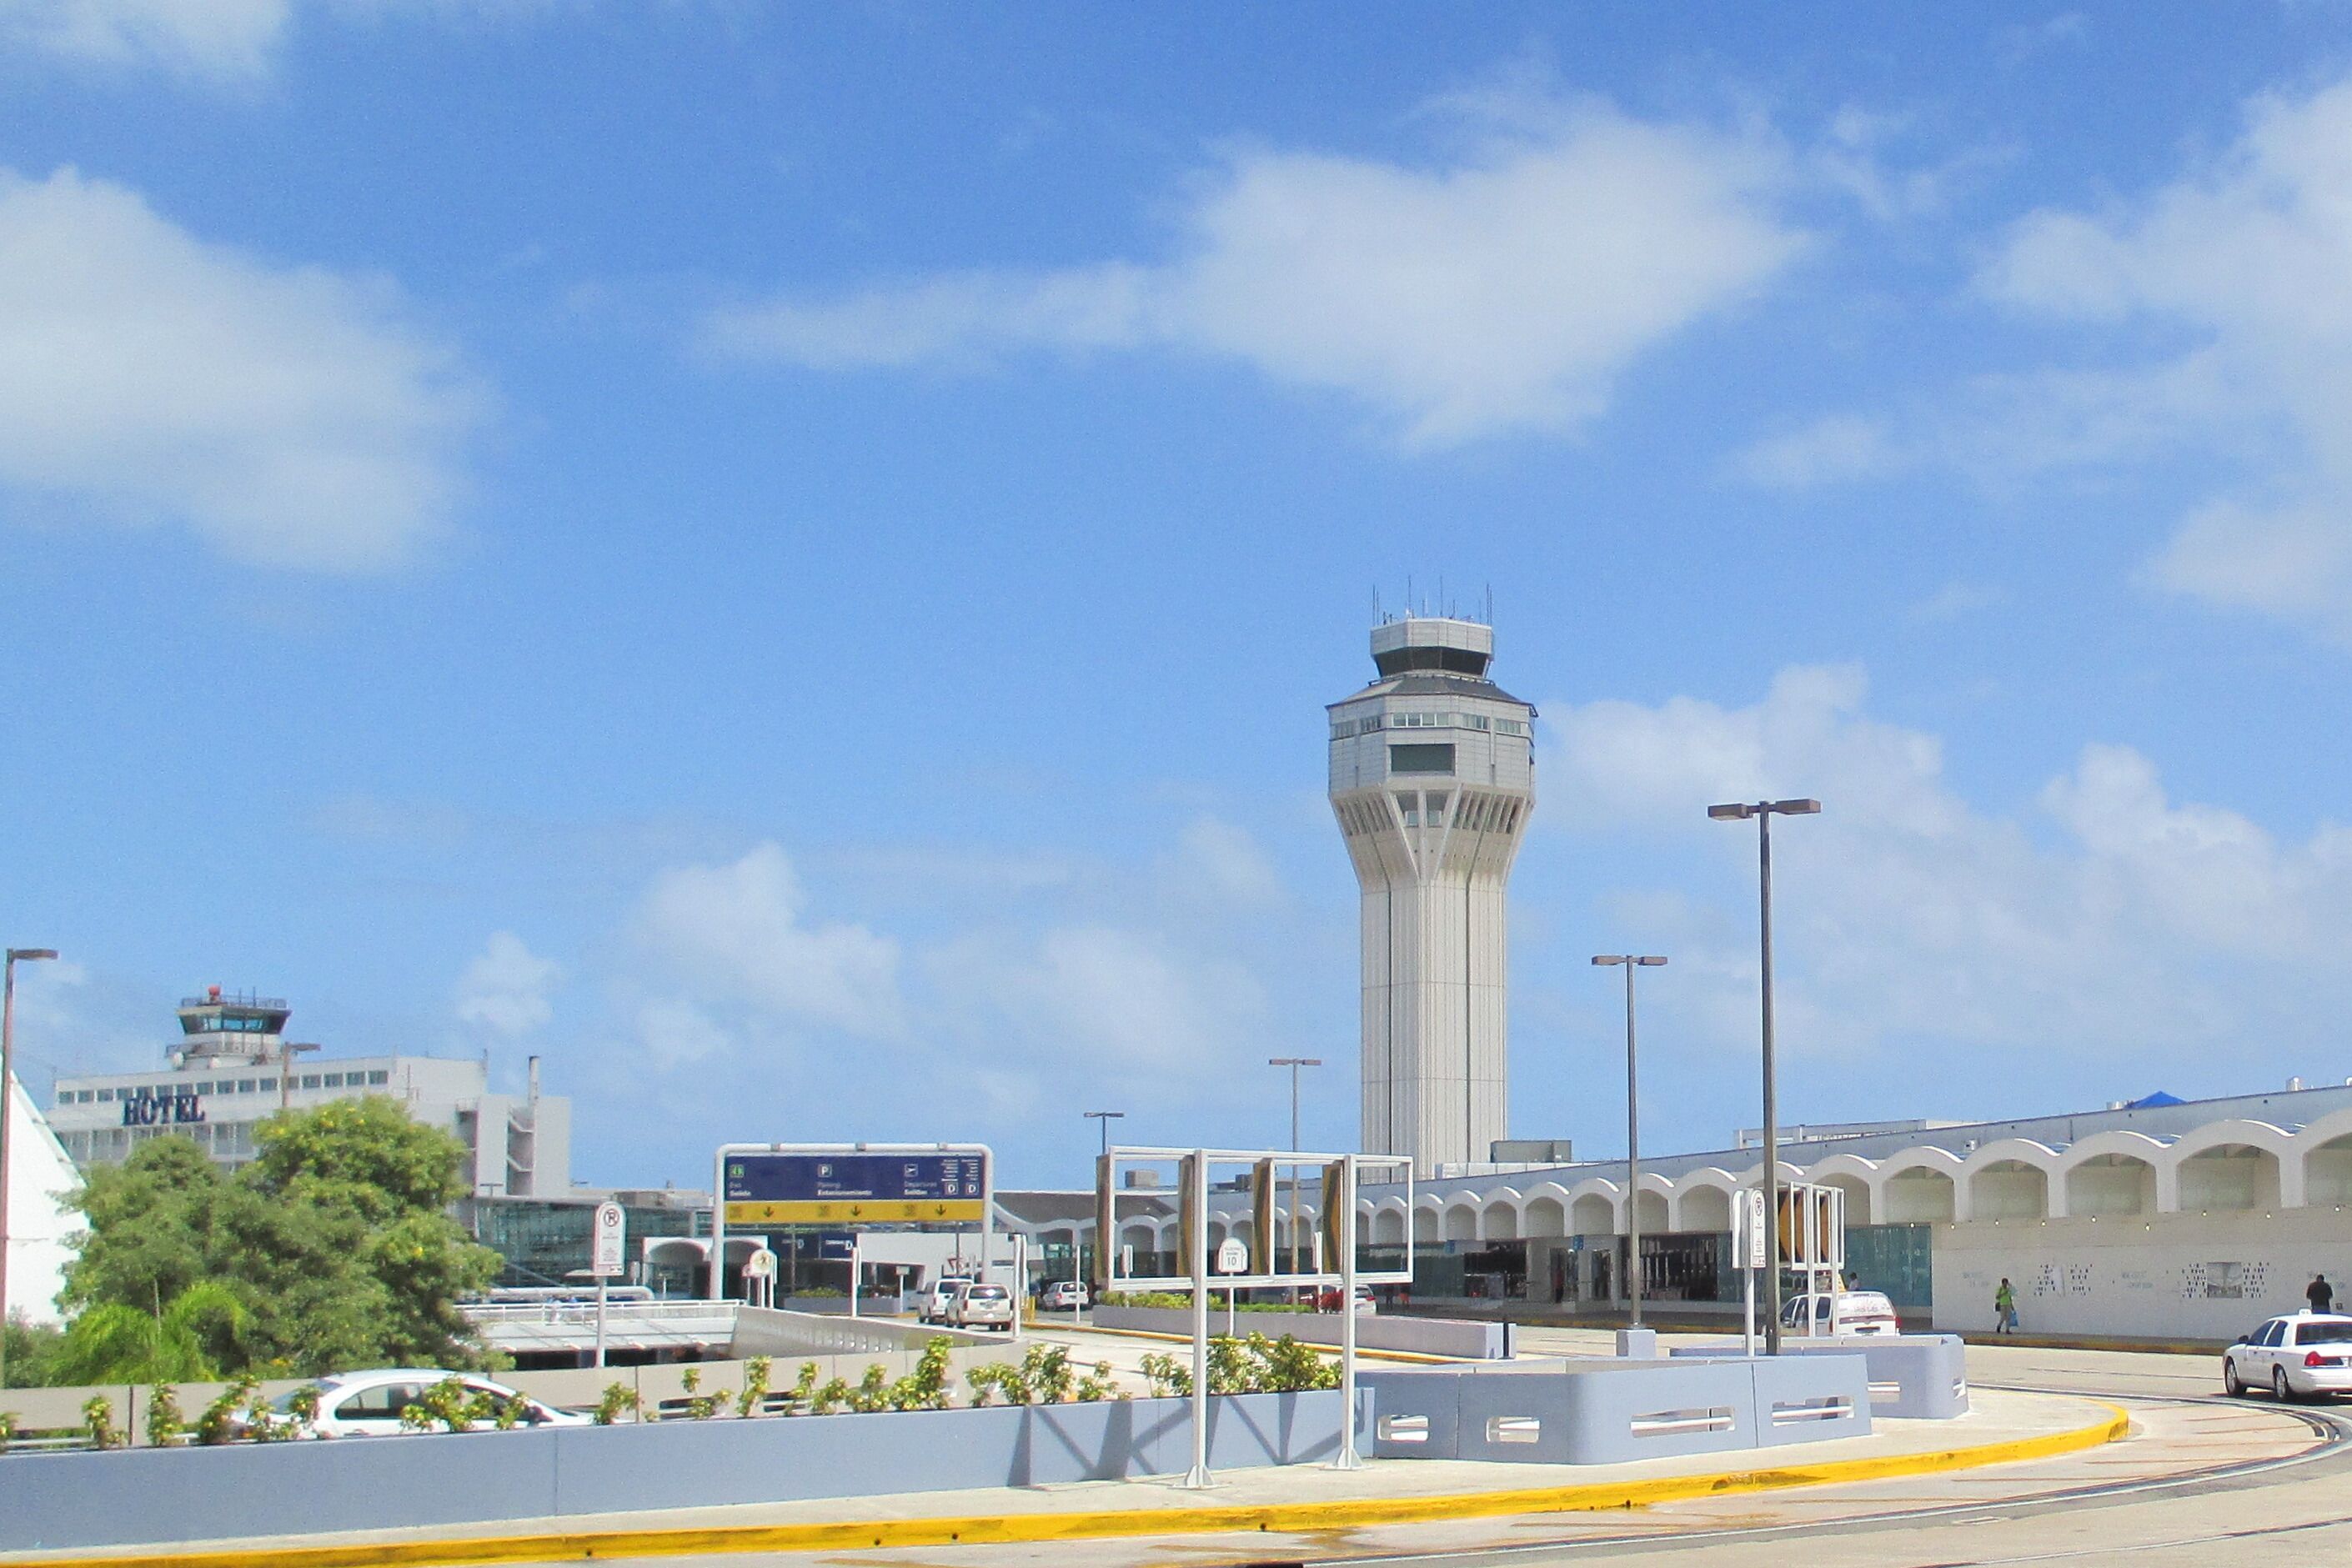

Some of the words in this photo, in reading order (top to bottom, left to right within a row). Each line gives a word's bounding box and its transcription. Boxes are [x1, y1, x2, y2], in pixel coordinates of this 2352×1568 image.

[123, 1094, 205, 1125] HOTEL
[948, 1184, 955, 1193] D
[968, 1184, 976, 1193] D
[797, 1239, 805, 1250] D
[845, 1240, 853, 1250] D
[1227, 1256, 1237, 1266] 10
